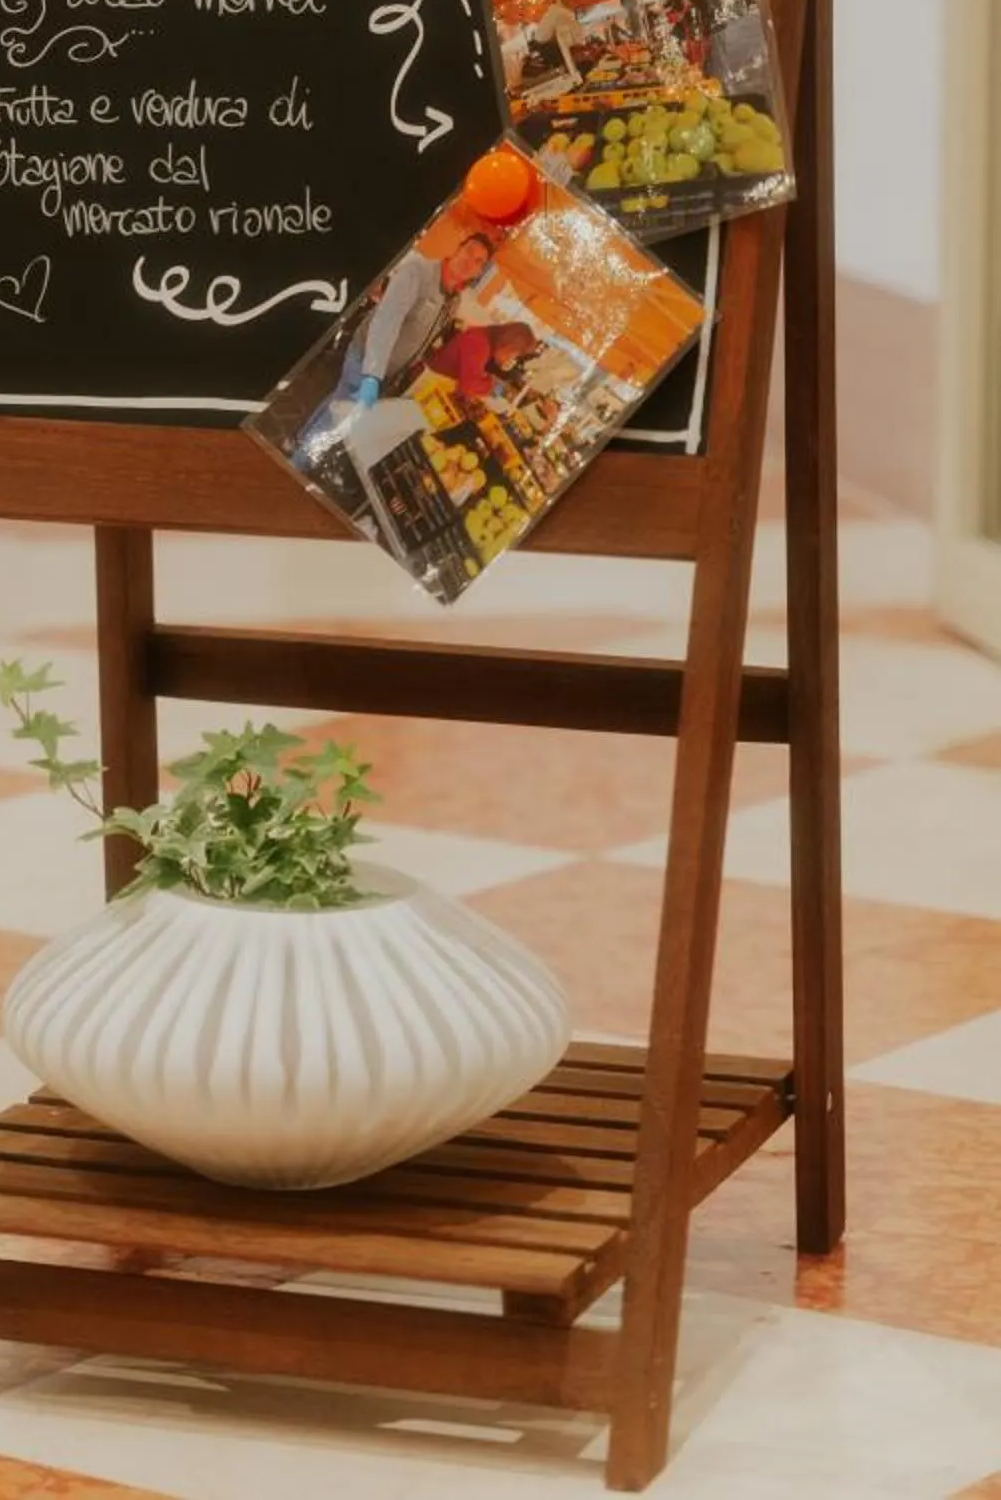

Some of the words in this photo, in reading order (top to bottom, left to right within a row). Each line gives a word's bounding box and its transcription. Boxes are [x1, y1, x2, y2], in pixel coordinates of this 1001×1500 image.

[89, 94, 121, 125] e
[130, 77, 249, 129] verdura
[268, 75, 315, 131] di
[148, 141, 211, 193] dal
[62, 195, 198, 239] mercato
[208, 184, 334, 238] rionale
